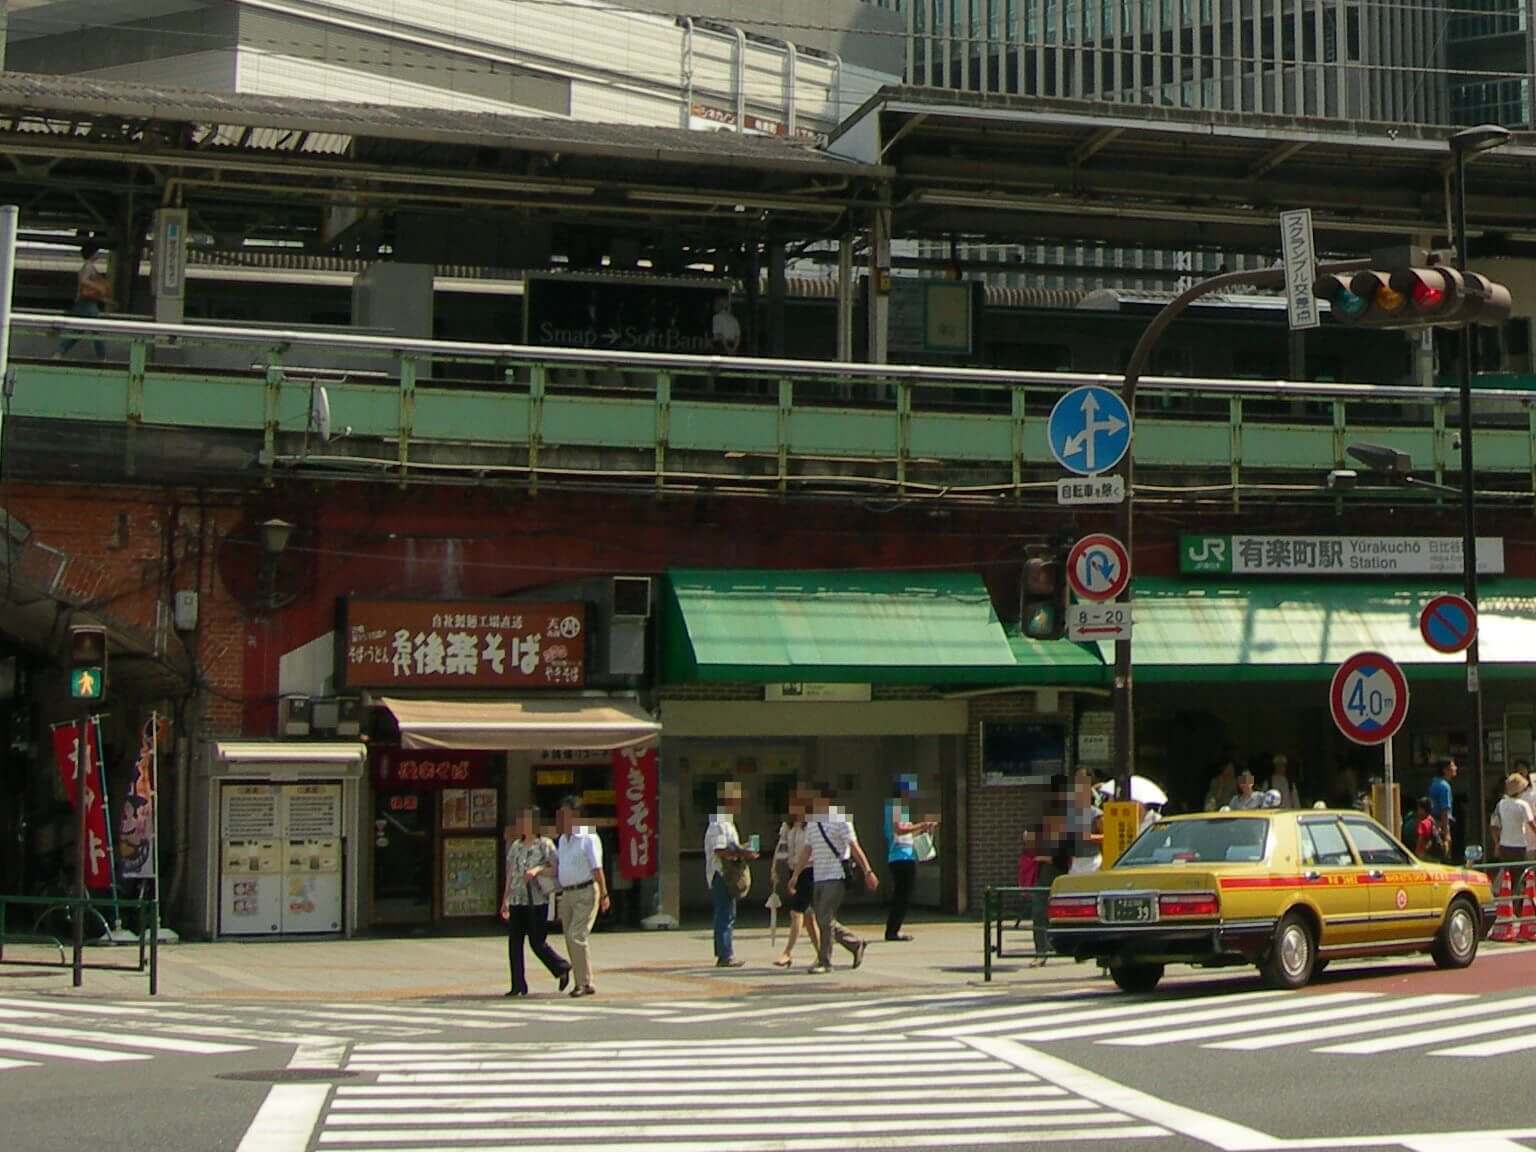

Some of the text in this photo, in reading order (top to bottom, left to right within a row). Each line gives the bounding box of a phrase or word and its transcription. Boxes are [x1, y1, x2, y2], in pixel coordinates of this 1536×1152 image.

[1288, 216, 1311, 322] スクランブル交差点
[1188, 538, 1226, 561] JR
[1239, 538, 1343, 569] 有楽町駅
[1350, 556, 1398, 569] Station
[413, 631, 542, 675] 後楽そば
